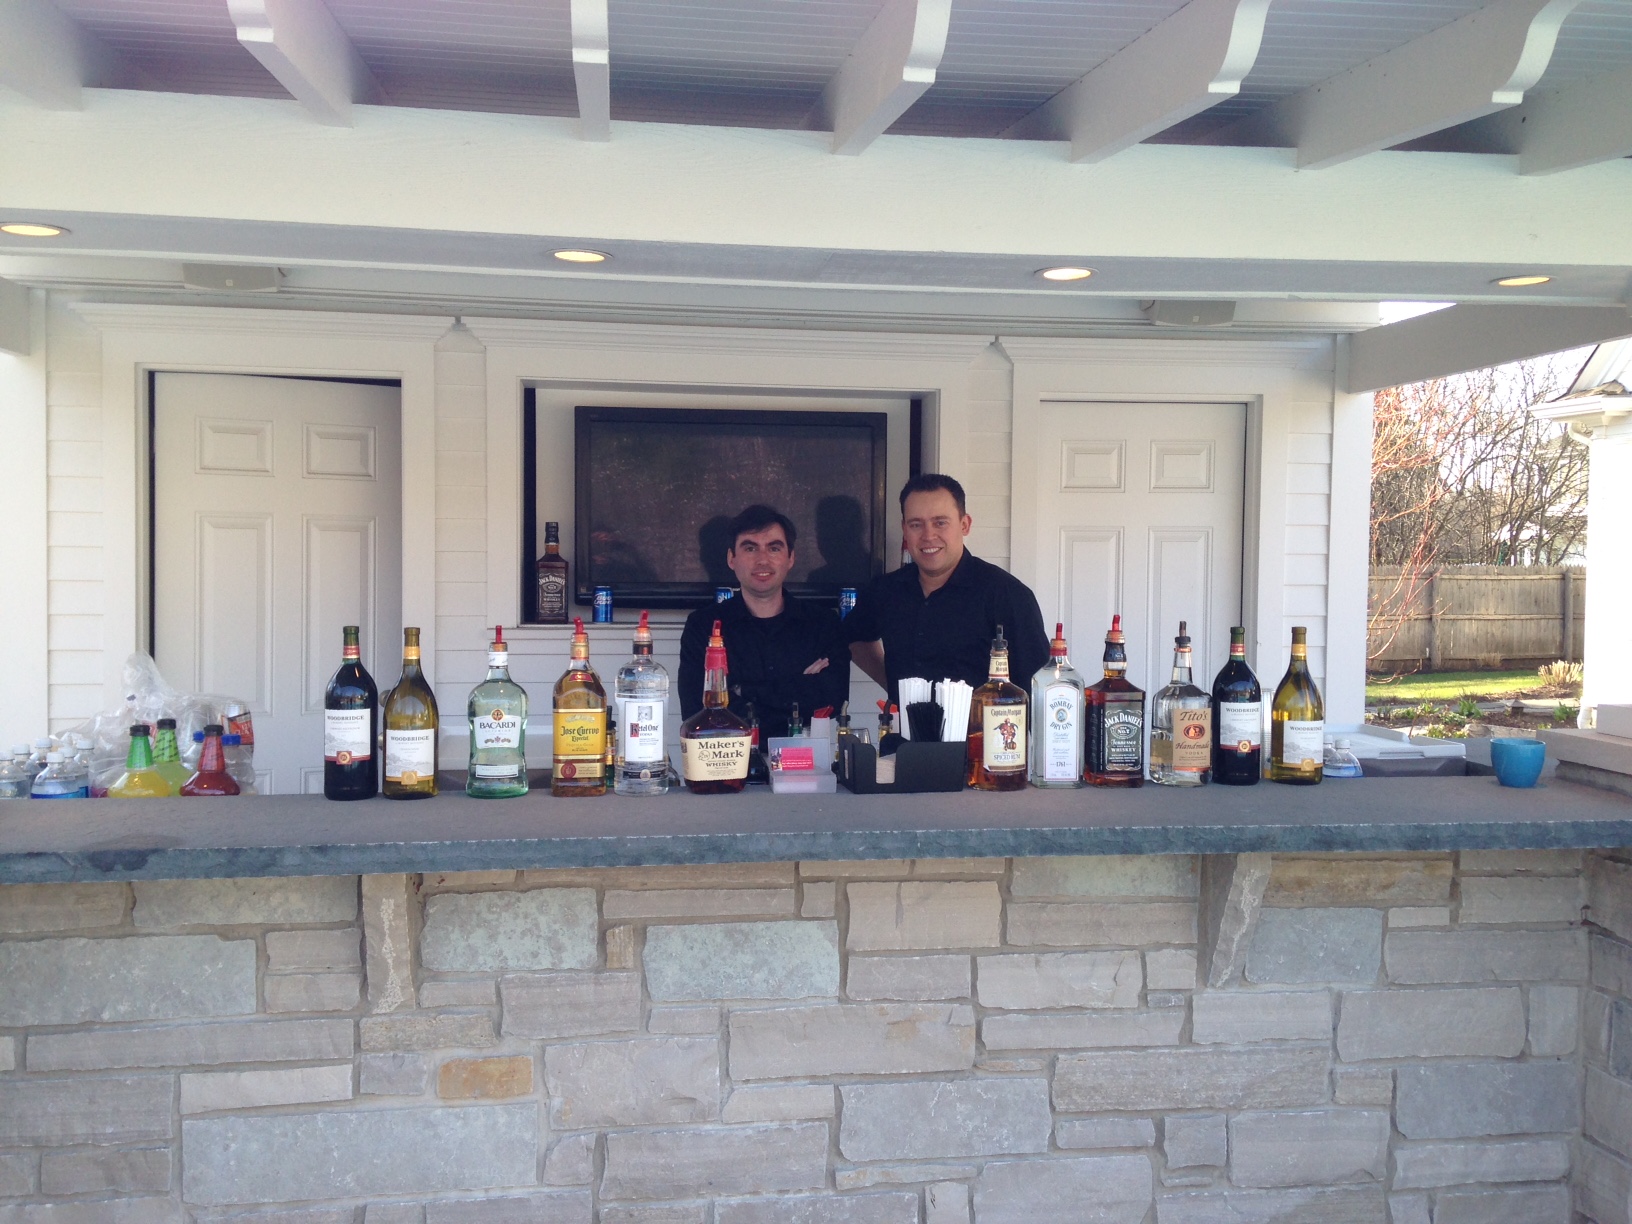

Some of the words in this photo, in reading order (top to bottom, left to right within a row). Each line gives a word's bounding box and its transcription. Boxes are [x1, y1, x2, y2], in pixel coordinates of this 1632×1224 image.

[1049, 700, 1073, 710] BOMBAY
[1180, 711, 1208, 721] Tito's
[479, 721, 516, 729] BACARDI
[1049, 721, 1061, 731] DRY
[1061, 721, 1073, 731] GIN
[1104, 715, 1120, 728] JACK
[560, 725, 576, 737] Jose
[647, 724, 658, 732] One
[697, 740, 745, 750] Maker's
[711, 749, 744, 760] Mark
